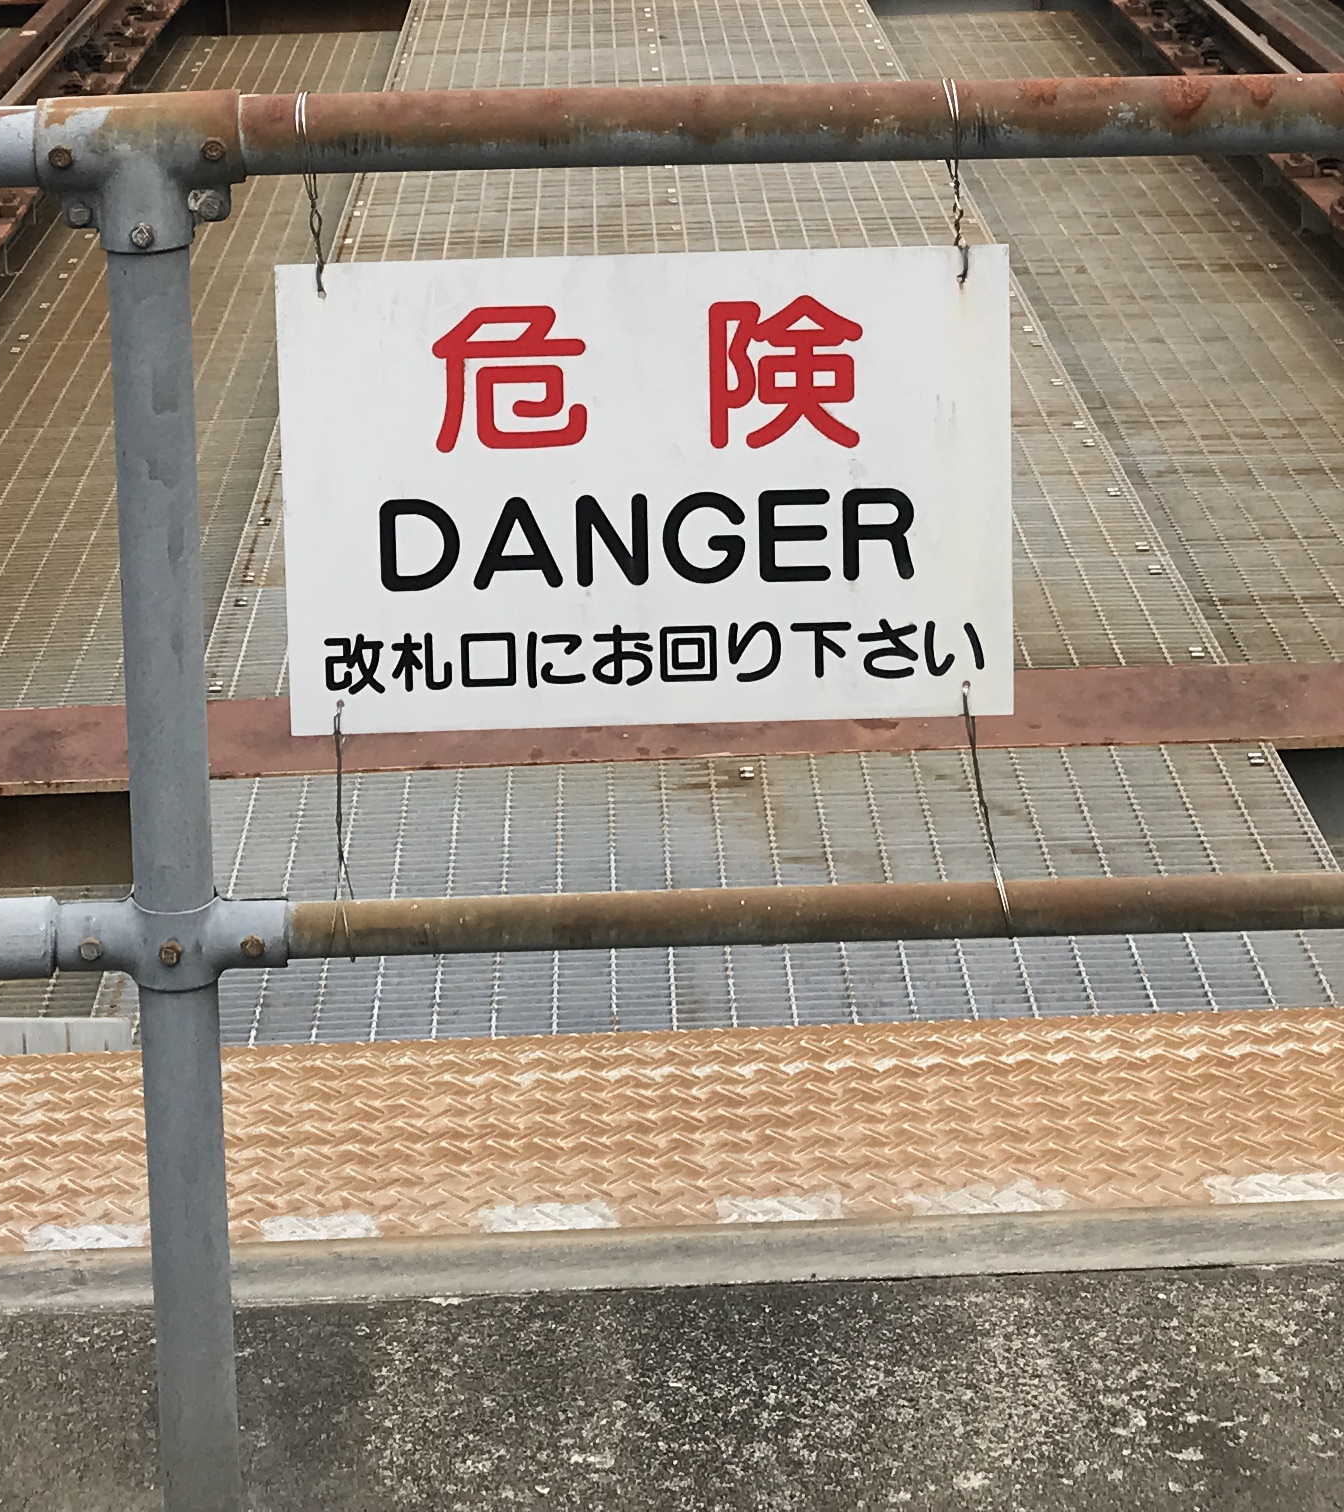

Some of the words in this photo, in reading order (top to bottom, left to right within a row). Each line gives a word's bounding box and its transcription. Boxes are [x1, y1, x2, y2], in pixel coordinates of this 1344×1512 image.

[431, 294, 864, 453] 危険
[378, 487, 915, 592] DANGER
[323, 618, 985, 695] 改札口にお回り下さい
